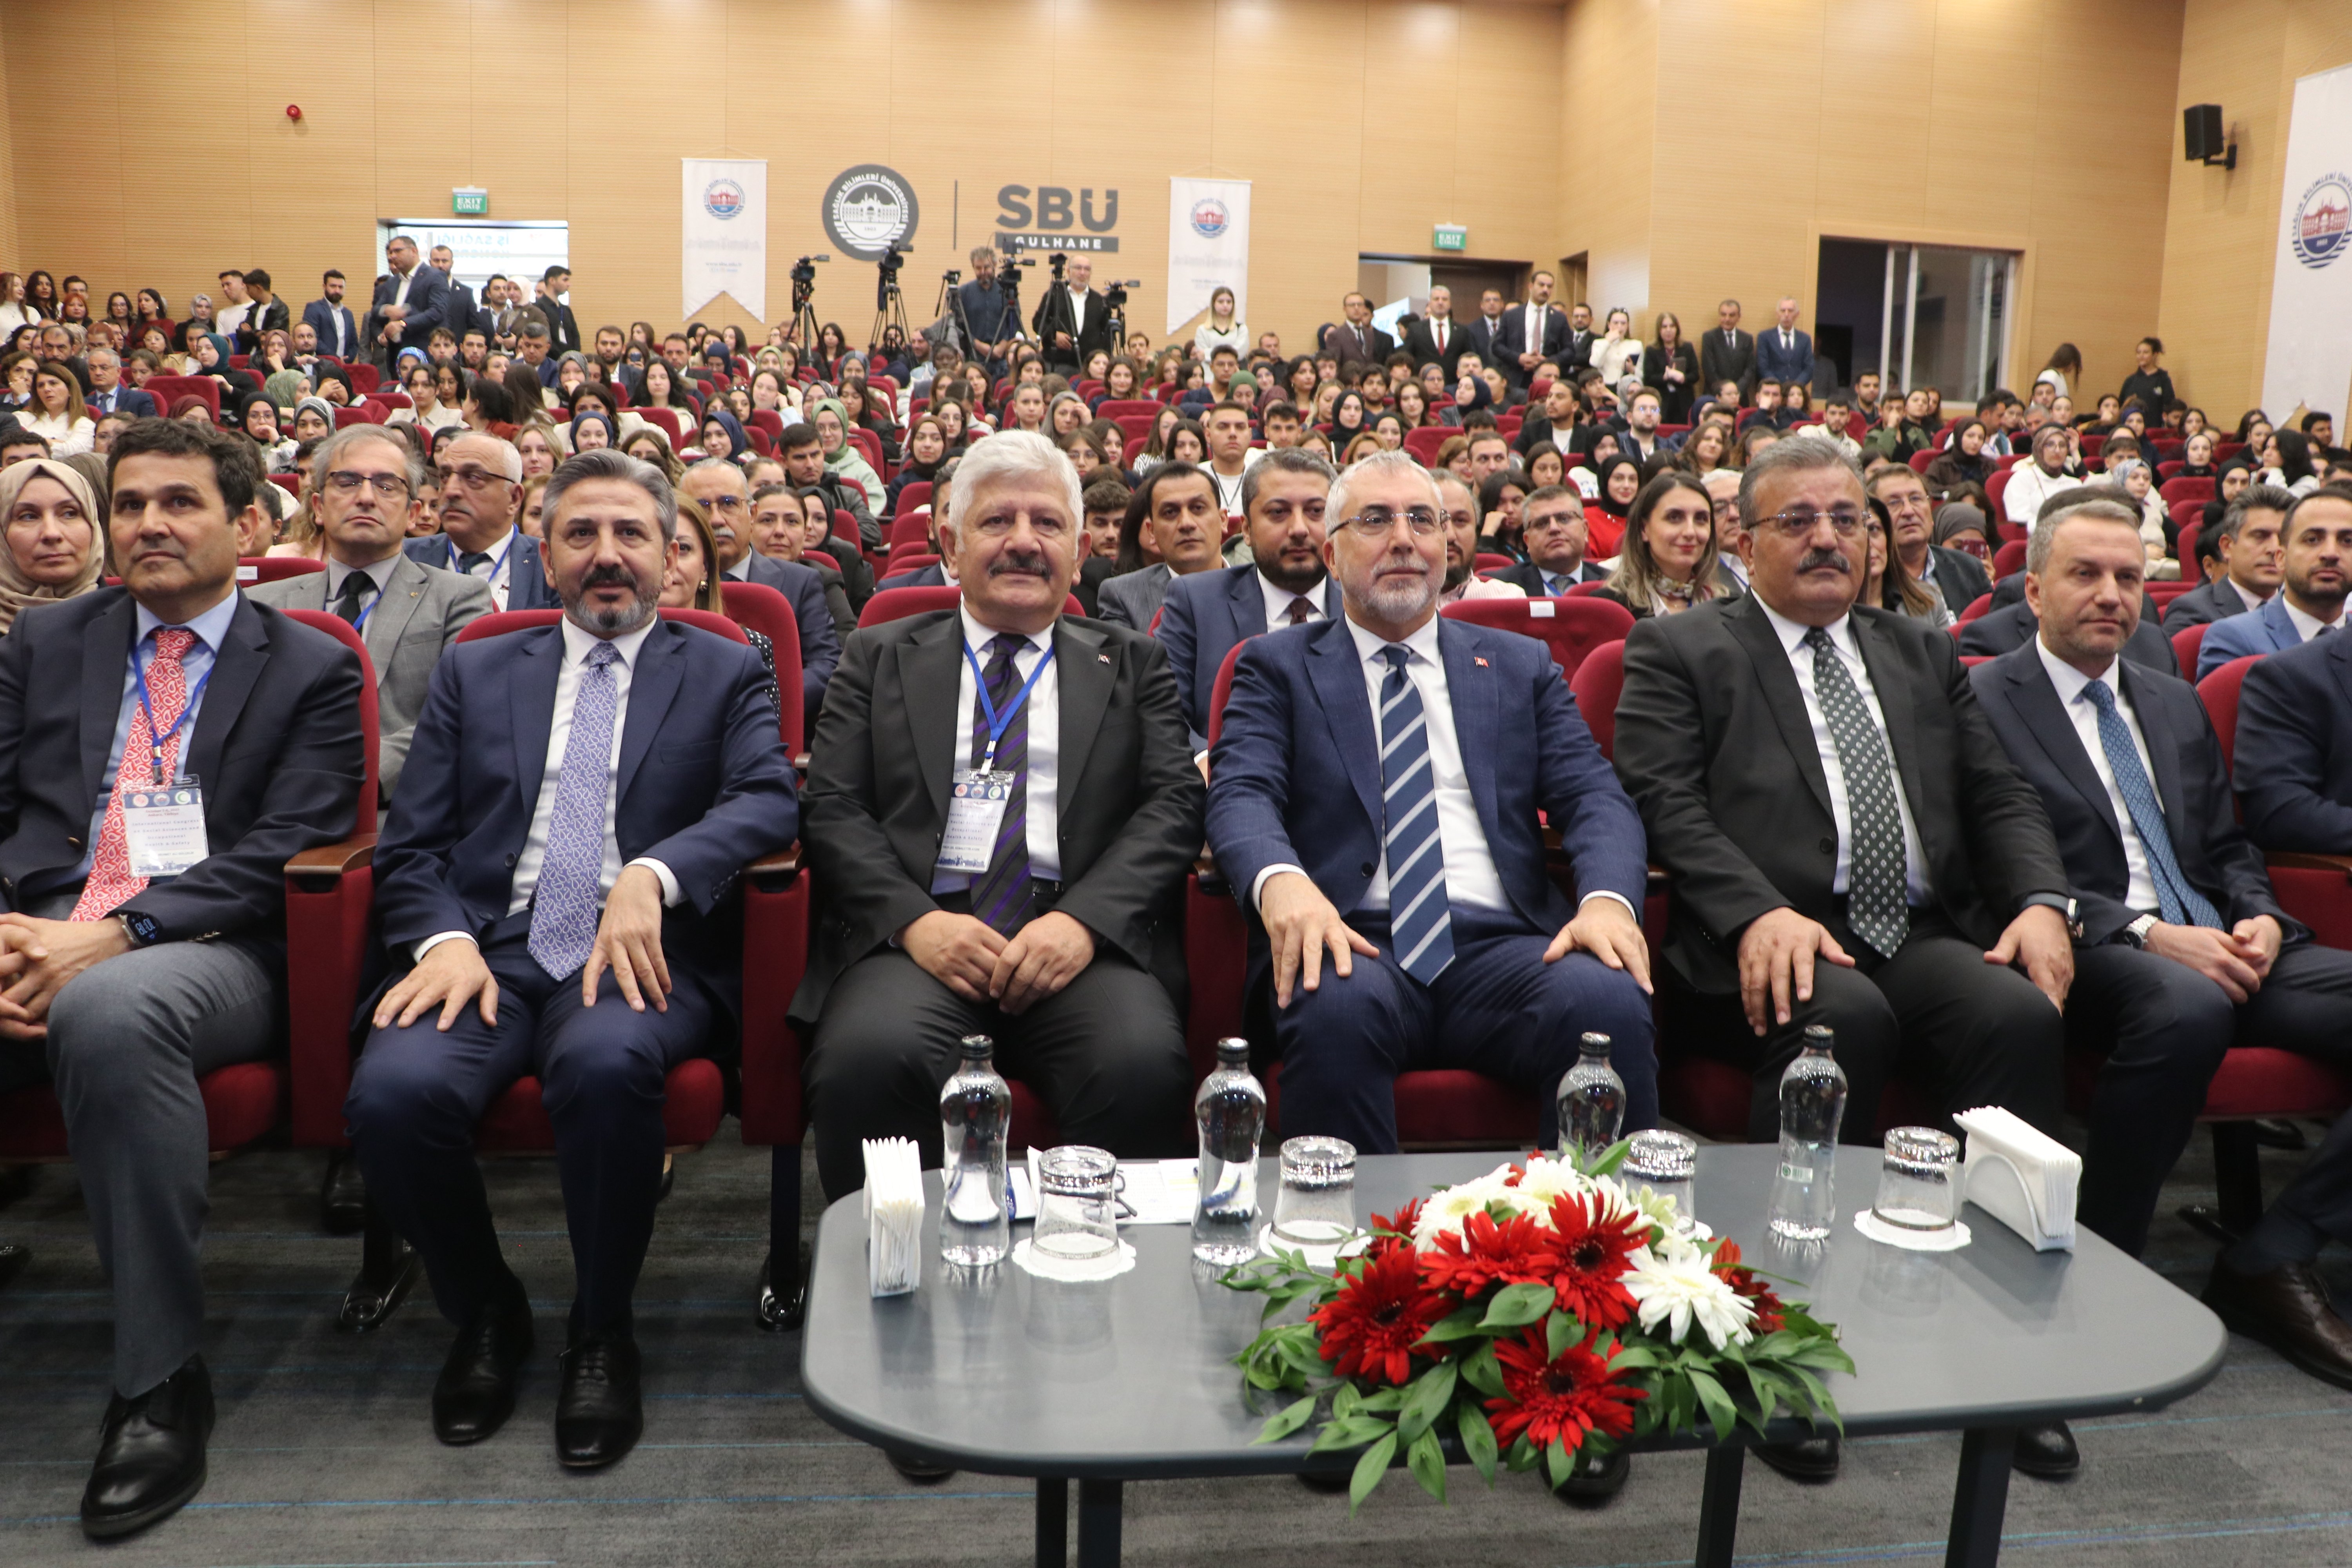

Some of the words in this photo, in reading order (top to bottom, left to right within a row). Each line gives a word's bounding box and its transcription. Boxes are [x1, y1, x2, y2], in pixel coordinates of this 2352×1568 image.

[832, 190, 844, 220] SAĞLIK
[842, 172, 879, 191] BİLİMLERİ
[880, 175, 909, 223] ÜNİVERSİTESİ
[135, 918, 156, 935] 10:18
